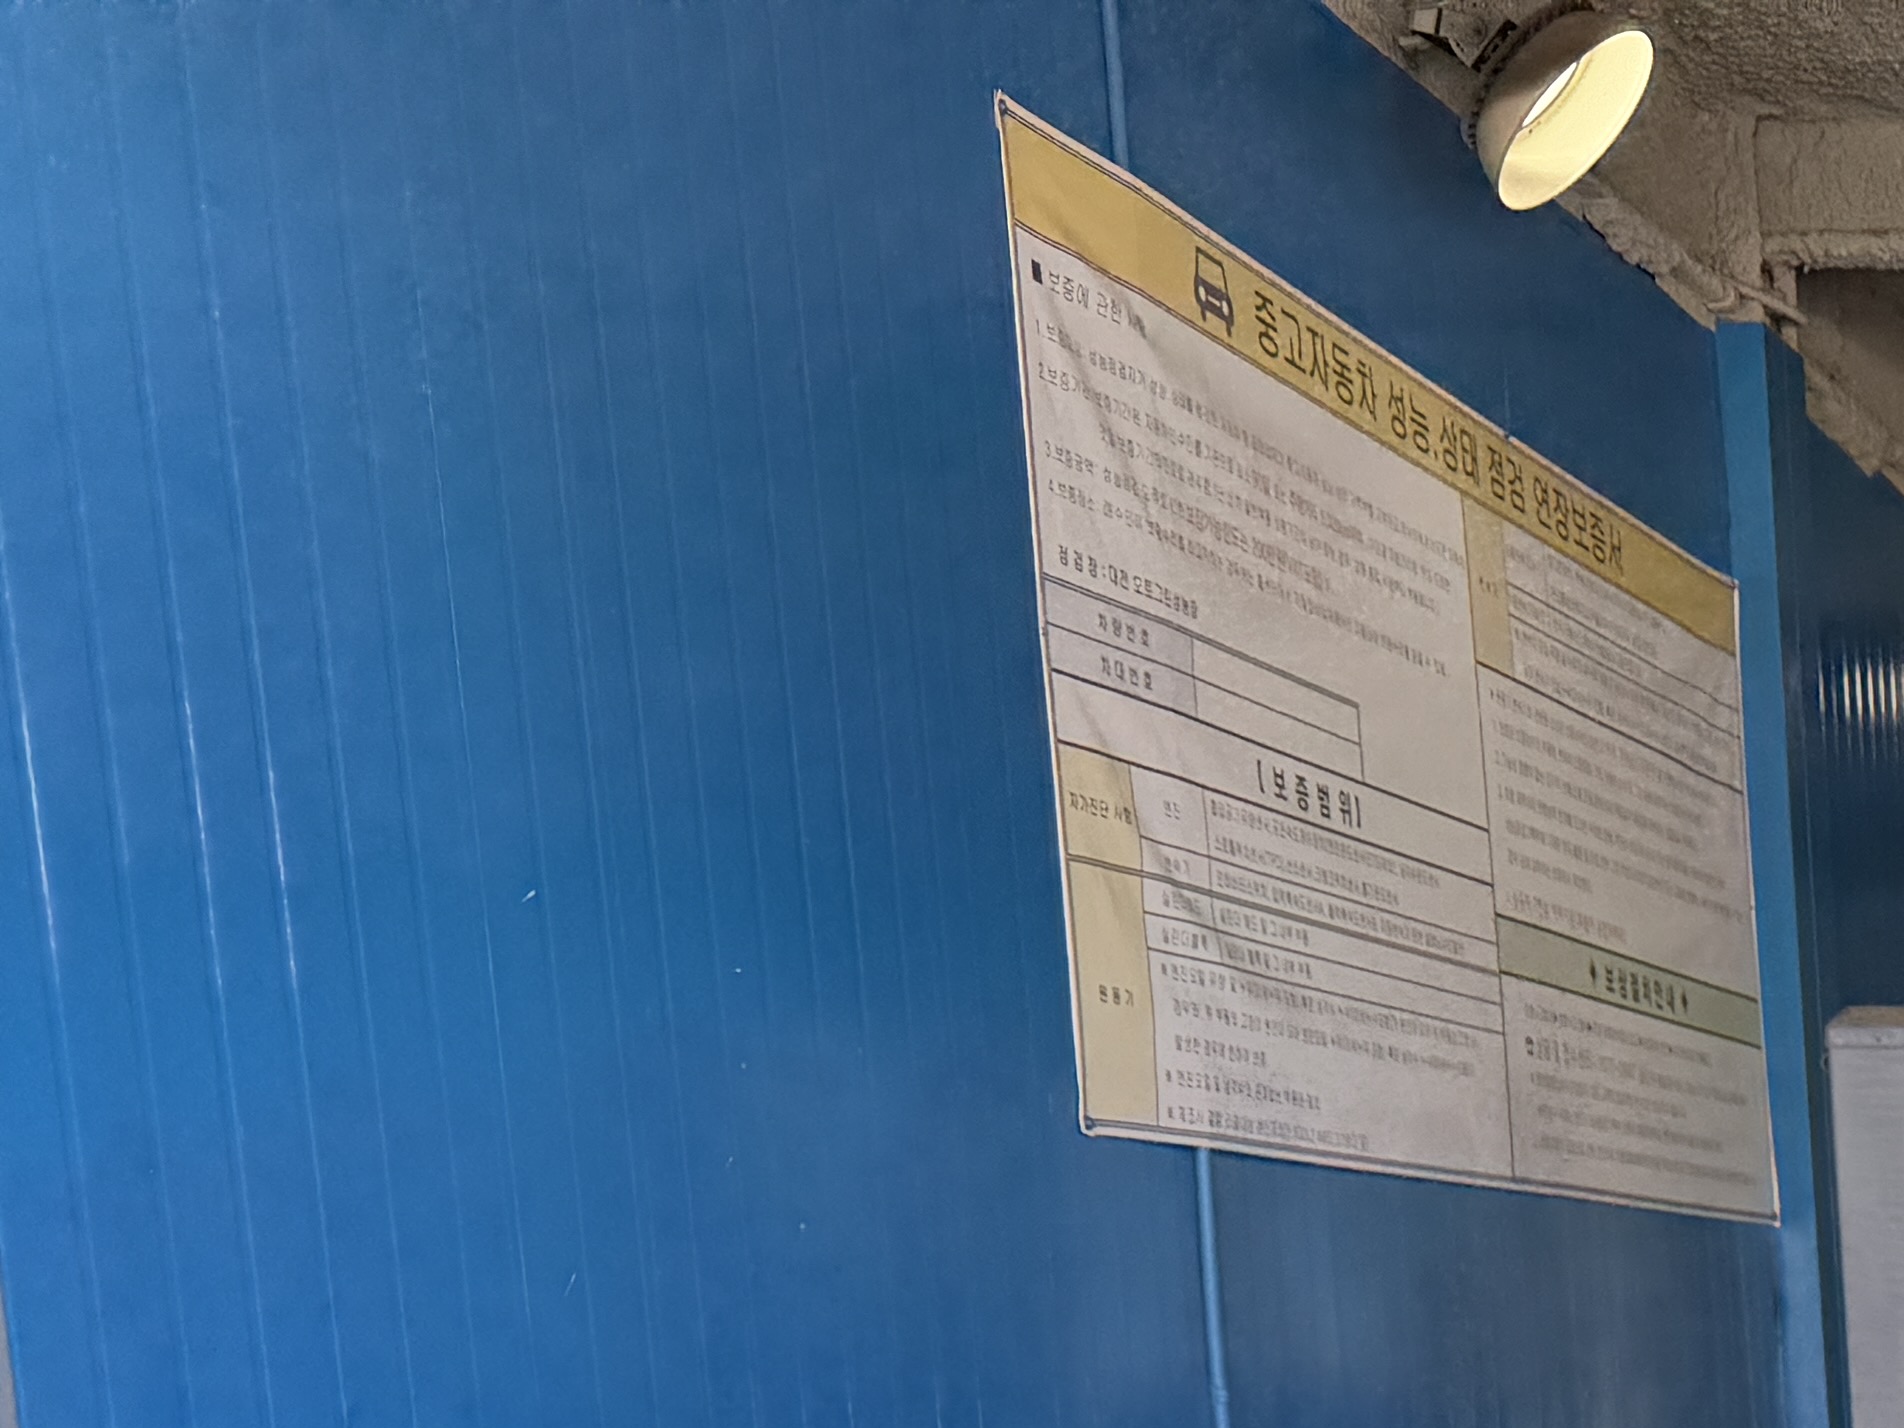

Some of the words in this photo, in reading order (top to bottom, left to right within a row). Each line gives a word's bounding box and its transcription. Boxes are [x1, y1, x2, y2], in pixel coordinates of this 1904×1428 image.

[1254, 290, 1377, 421] 중고자동차
[1487, 445, 1525, 513] 점검
[1533, 475, 1624, 575] 연장보증서
